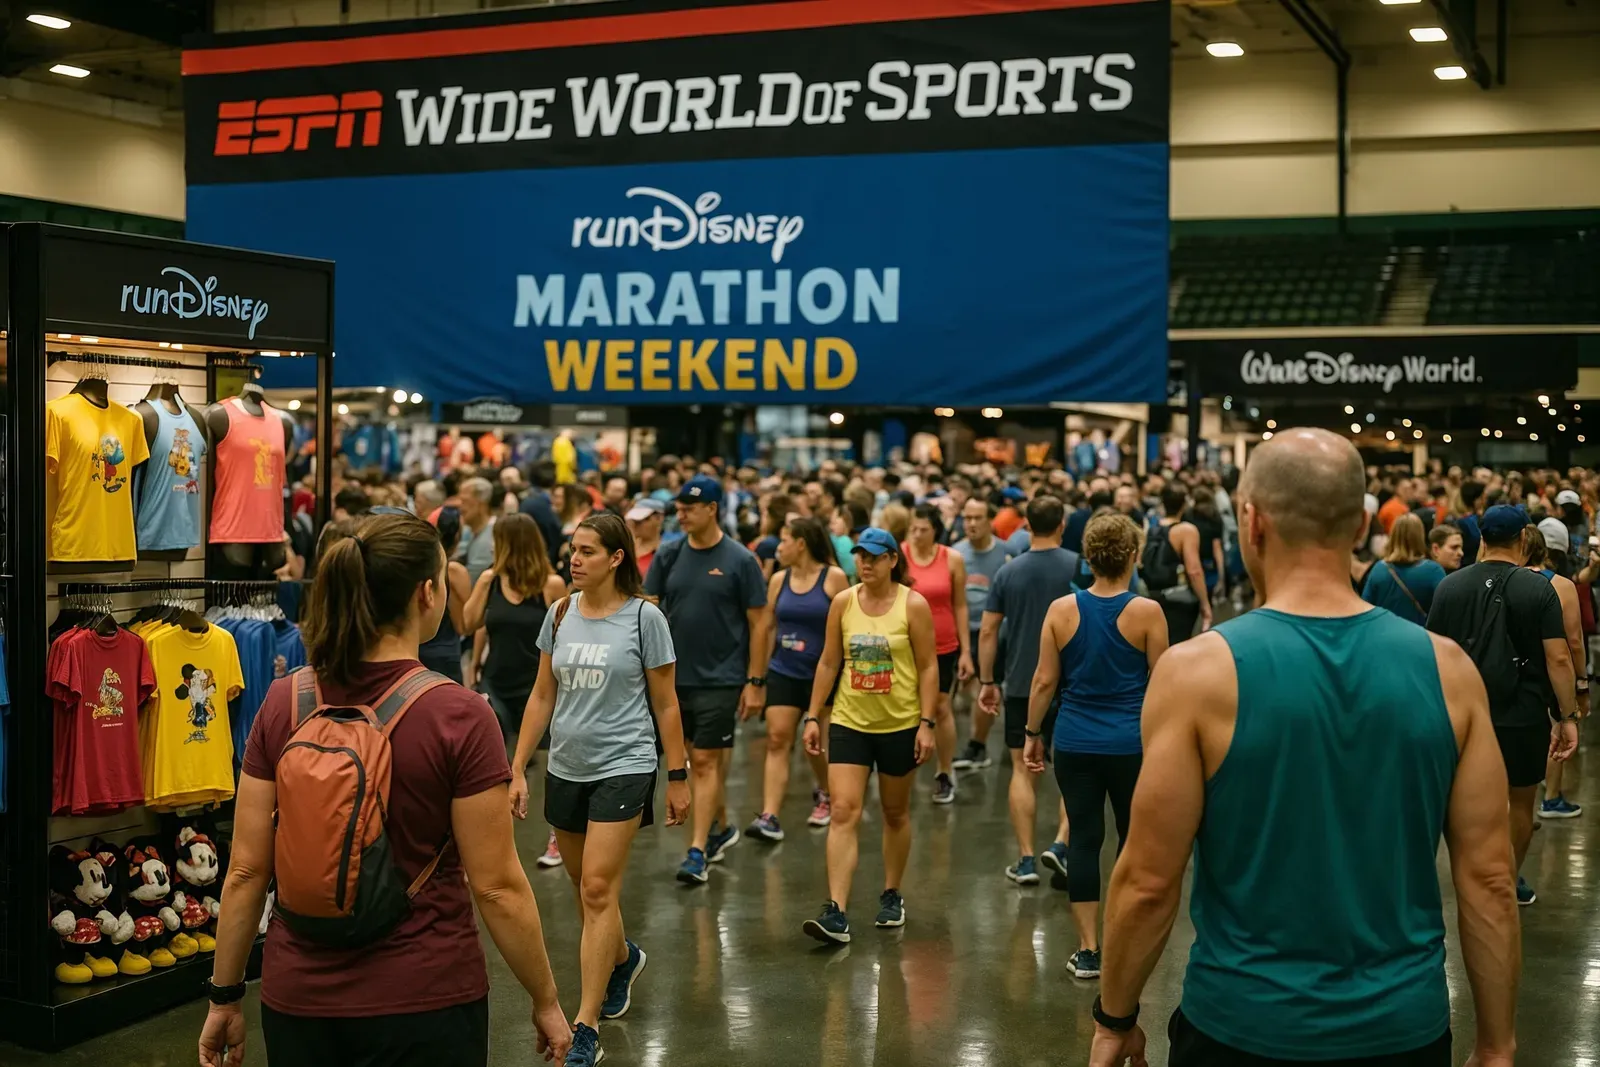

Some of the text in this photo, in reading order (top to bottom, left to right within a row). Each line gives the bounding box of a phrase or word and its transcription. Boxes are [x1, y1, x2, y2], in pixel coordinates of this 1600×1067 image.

[215, 53, 1136, 155] ESPN WIDE WORLD OF SPORTS
[514, 267, 900, 327] MARATHON
[544, 337, 858, 391] WEEKEND
[567, 642, 610, 666] THE
